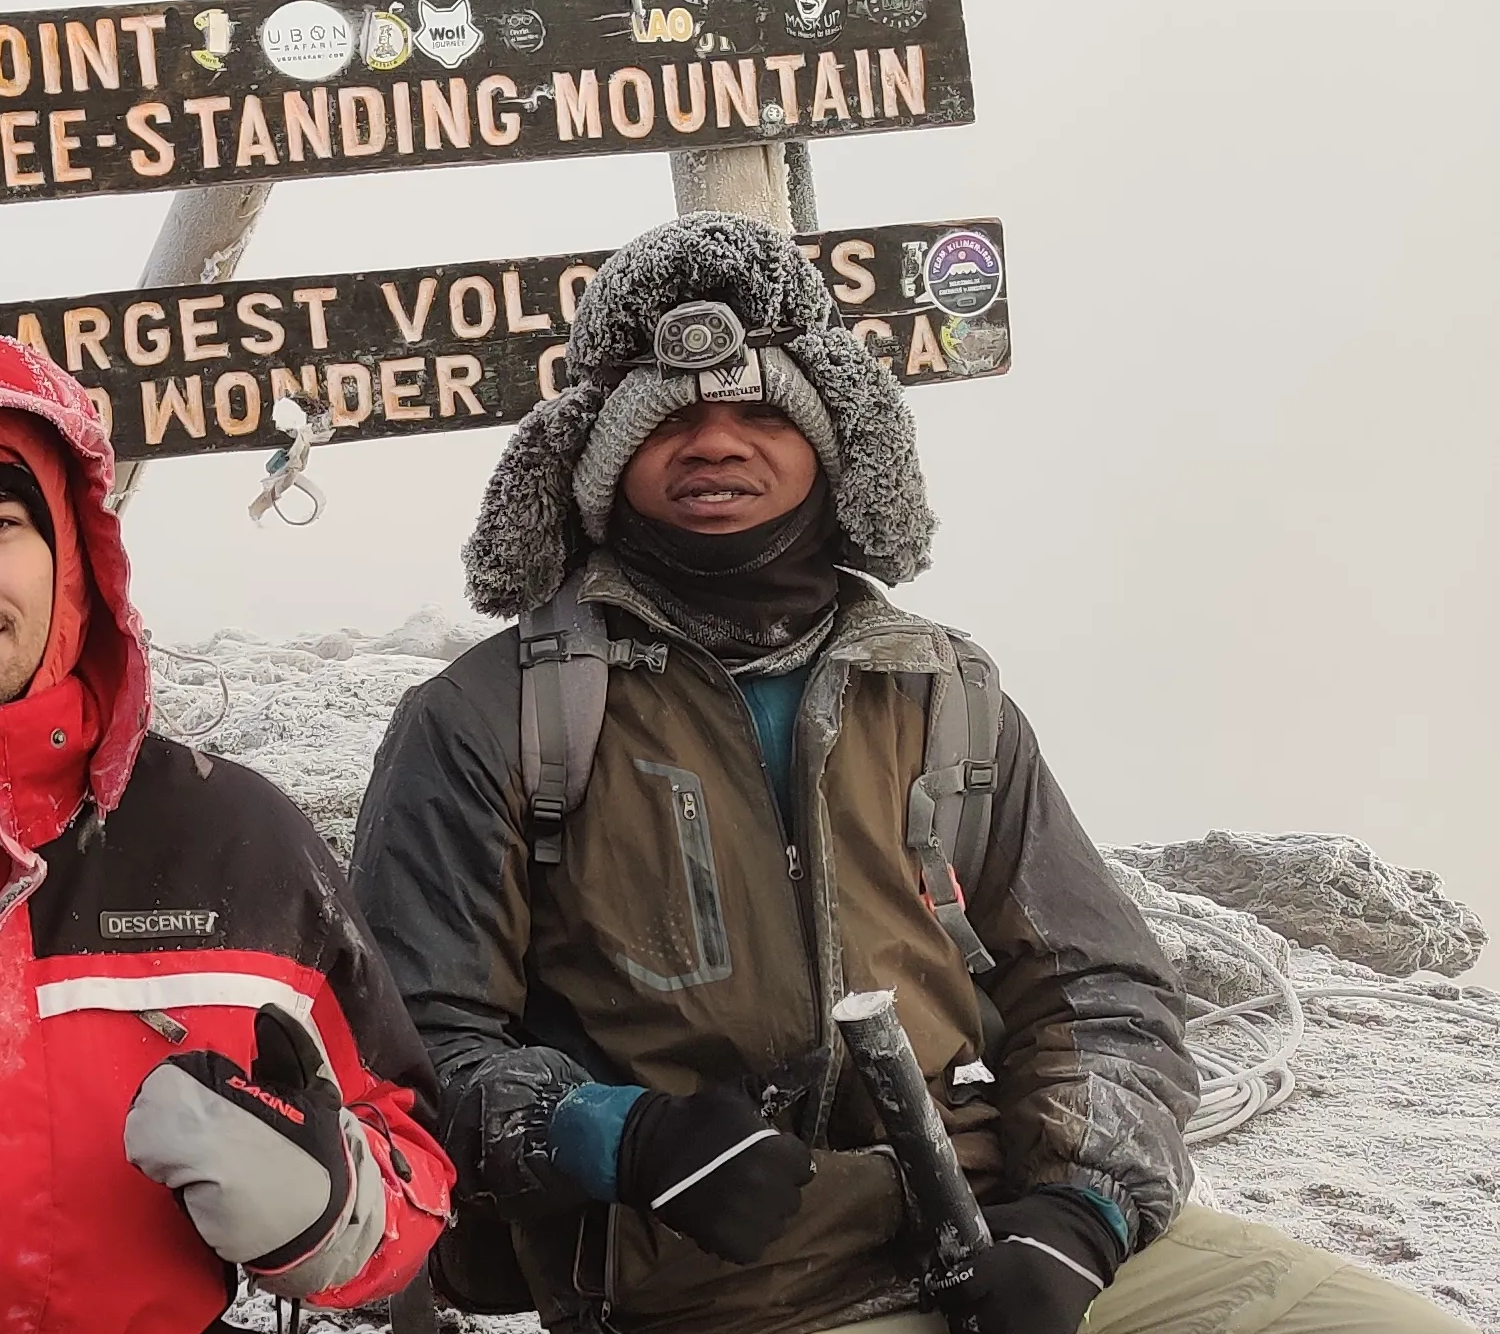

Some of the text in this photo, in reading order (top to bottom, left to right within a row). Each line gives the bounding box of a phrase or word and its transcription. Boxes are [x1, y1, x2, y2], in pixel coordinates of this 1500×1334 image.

[785, 12, 821, 33] MASK
[824, 9, 841, 27] UP
[284, 41, 332, 52] SAFARI
[552, 44, 927, 143] MOUNTAIN
[141, 353, 486, 445] WONDER
[108, 913, 208, 934] DESCENTE
